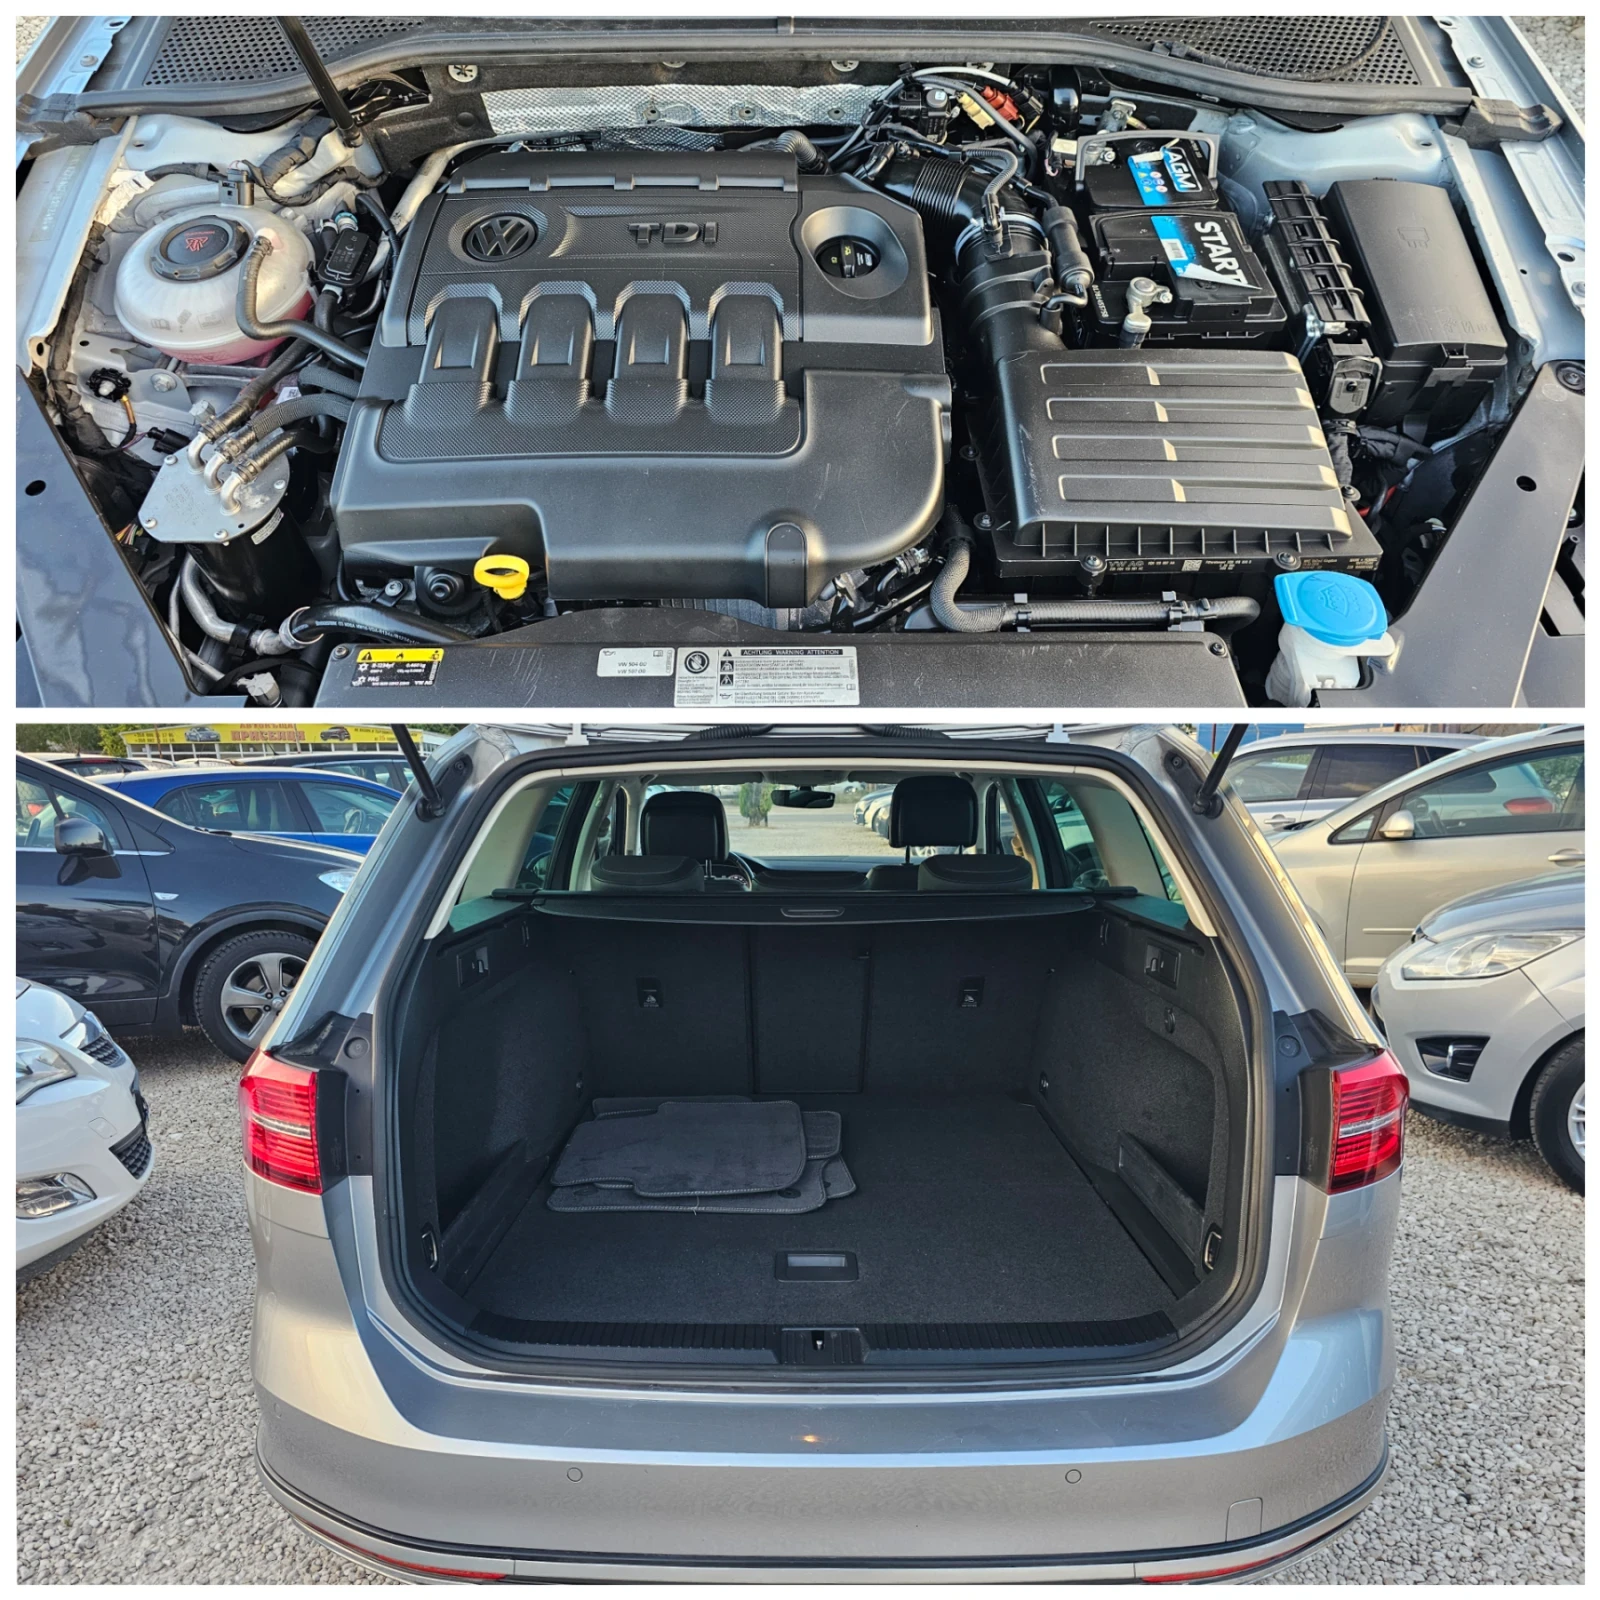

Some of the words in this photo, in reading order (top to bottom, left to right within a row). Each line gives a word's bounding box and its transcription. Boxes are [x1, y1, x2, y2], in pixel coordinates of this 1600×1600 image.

[1165, 150, 1197, 190] AGM
[628, 221, 718, 244] TDI
[1194, 220, 1249, 286] START
